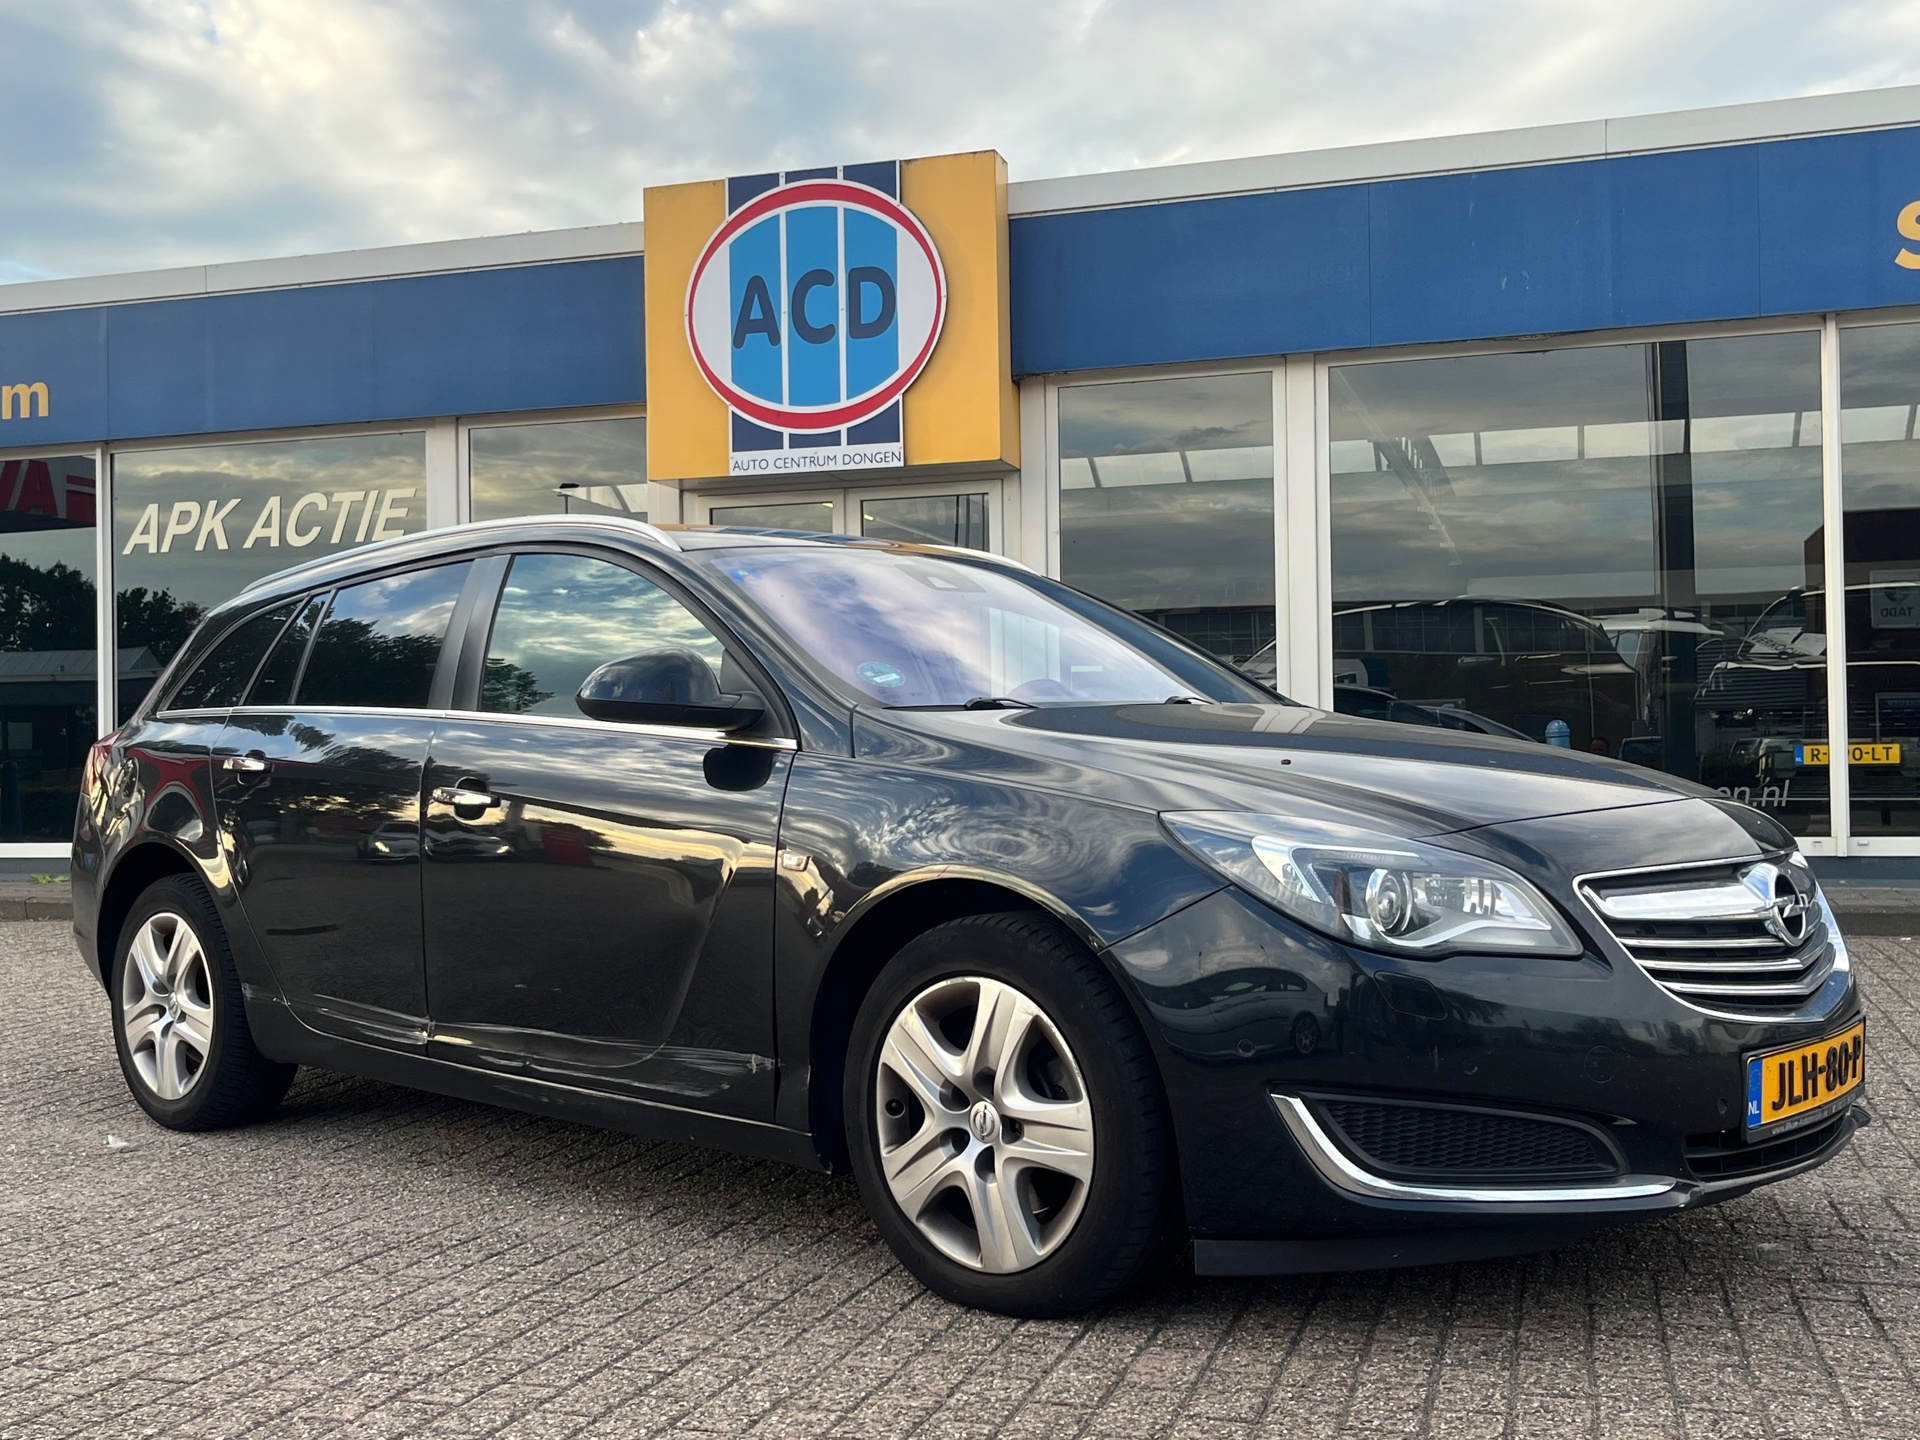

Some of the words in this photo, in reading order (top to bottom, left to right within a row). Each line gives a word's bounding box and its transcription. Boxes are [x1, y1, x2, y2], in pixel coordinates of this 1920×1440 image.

[732, 265, 897, 350] ACD
[732, 458, 769, 472] AUTO
[773, 454, 838, 469] CENTRUM
[842, 450, 902, 466] DONGEN
[121, 498, 242, 556] APK
[242, 487, 418, 549] ACTIE
[1771, 1033, 1862, 1112] JLH-80-P
[1748, 1101, 1760, 1115] NL
